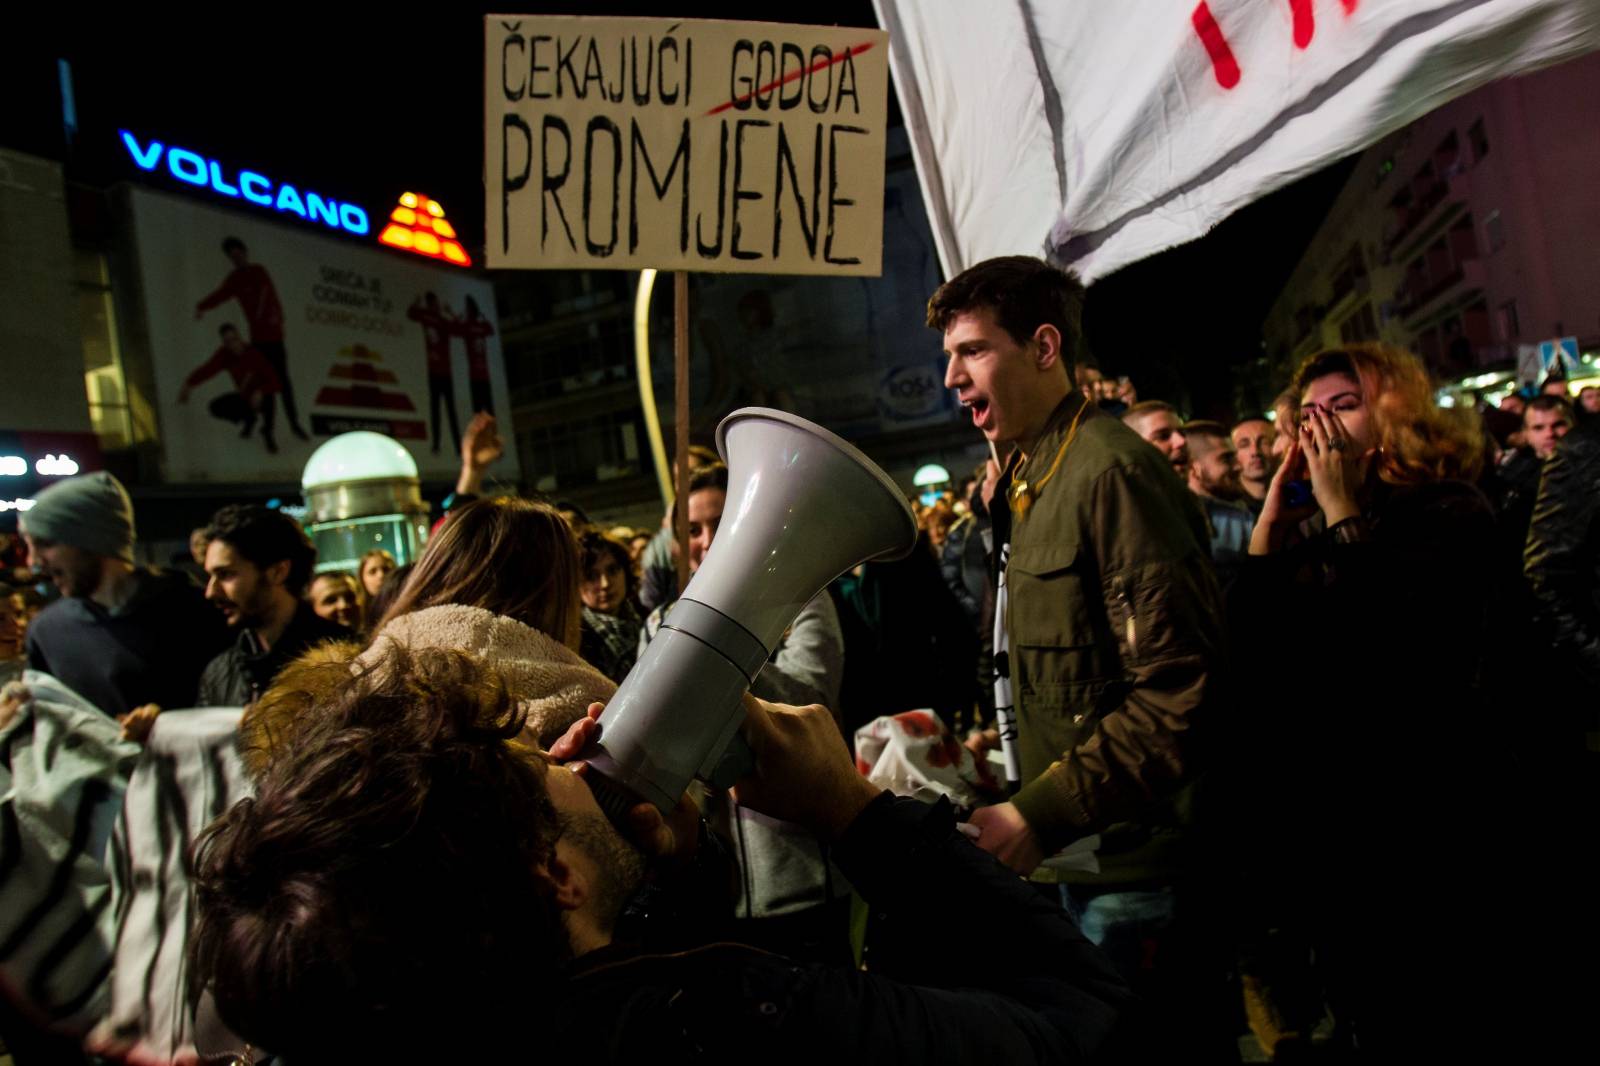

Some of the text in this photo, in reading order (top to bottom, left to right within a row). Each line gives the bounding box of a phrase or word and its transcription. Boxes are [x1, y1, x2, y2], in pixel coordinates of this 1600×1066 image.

[502, 21, 860, 114] ČEKAJUĆI GODOA
[119, 129, 369, 235] VOLCANO
[502, 113, 870, 265] PROMJENE
